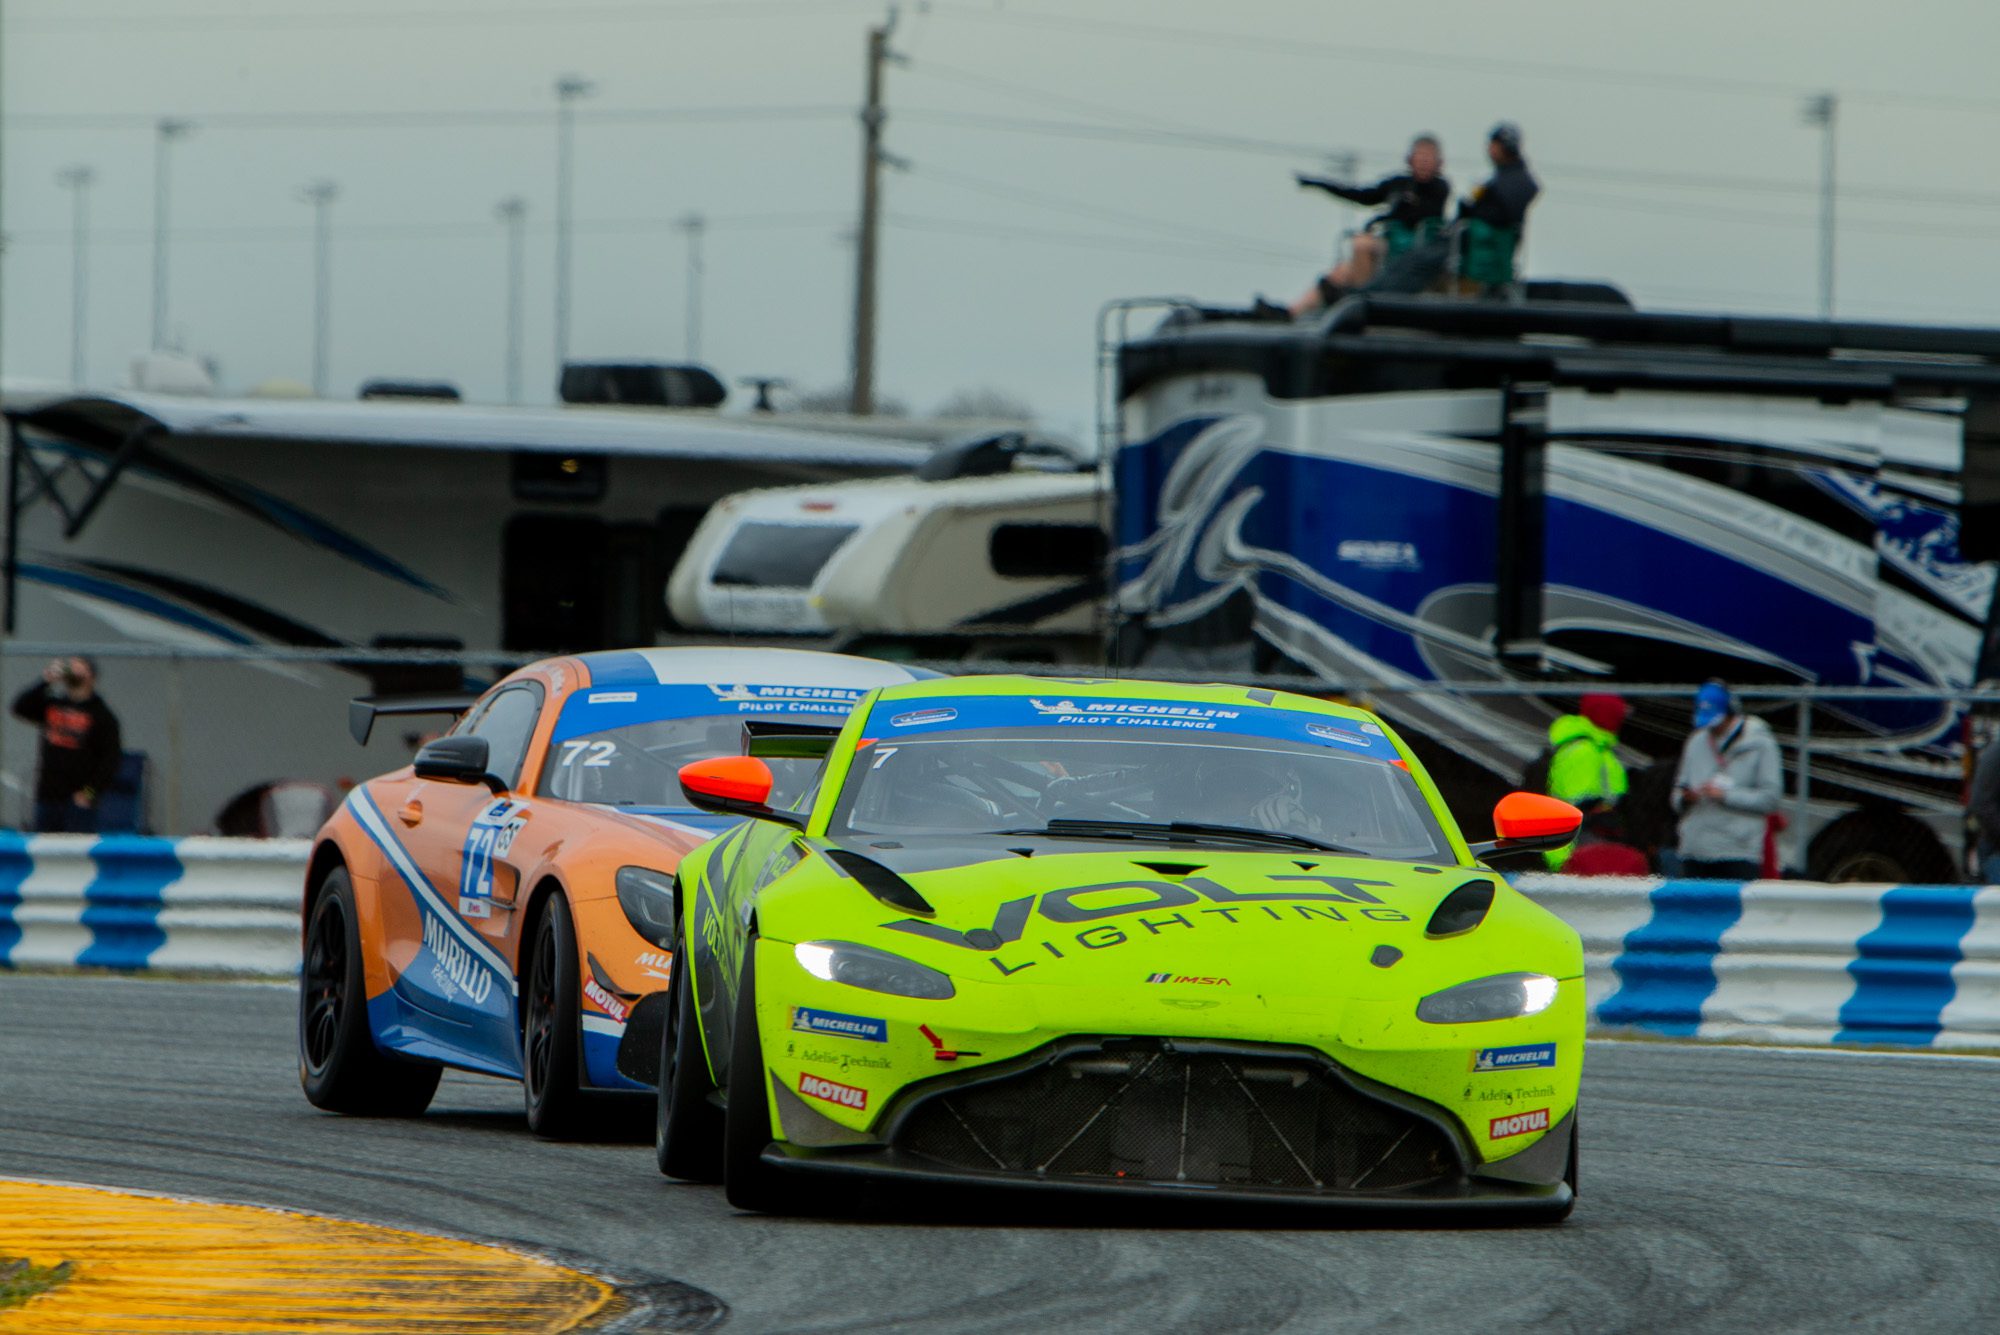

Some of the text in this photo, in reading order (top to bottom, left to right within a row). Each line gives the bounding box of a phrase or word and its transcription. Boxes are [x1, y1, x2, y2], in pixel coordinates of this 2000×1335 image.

[759, 686, 862, 700] MICHEL
[738, 702, 857, 716] PILOT CHALLE
[1086, 703, 1240, 720] MICHELIN
[1057, 715, 1217, 730] PILOT CHALLENGE
[562, 740, 616, 767] 72
[872, 747, 899, 769] 7
[464, 826, 496, 896] 72
[877, 875, 1397, 951] VOLT
[988, 905, 1411, 977] LIGHTING
[423, 909, 493, 1005] MURILLO
[1173, 975, 1232, 987] IMSA
[583, 980, 626, 1021] MOTUL
[811, 1017, 880, 1036] MICHELIN
[841, 1054, 893, 1070] Technik
[1494, 1051, 1551, 1065] MICHELIN
[800, 1076, 866, 1109] MOTUL
[1515, 1083, 1556, 1100] Technik
[1492, 1111, 1549, 1138] MOTUL
